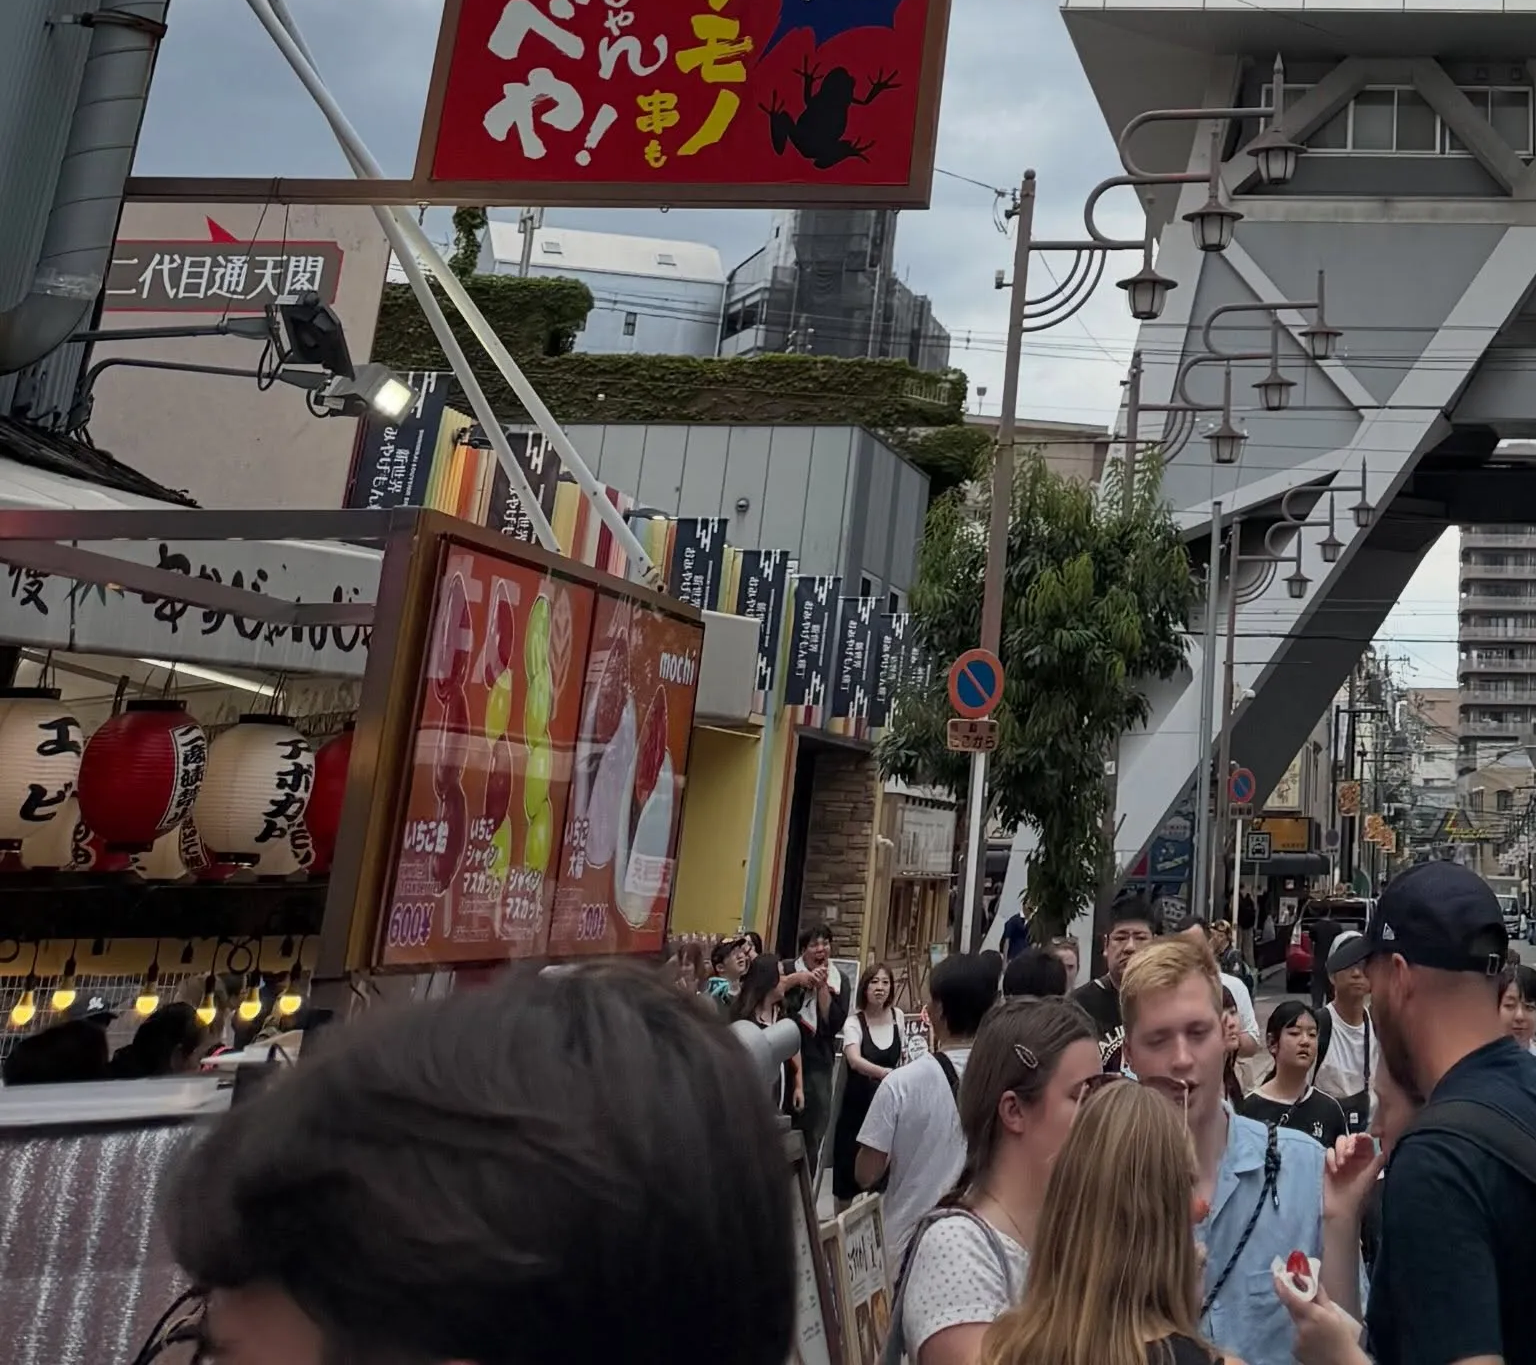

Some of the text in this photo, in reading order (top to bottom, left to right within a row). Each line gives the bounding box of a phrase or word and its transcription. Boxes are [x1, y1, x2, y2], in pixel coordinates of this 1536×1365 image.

[636, 89, 680, 169] 串も
[108, 253, 325, 303] 二代目通天閣
[658, 650, 696, 686] mochi
[19, 716, 83, 822] エビ
